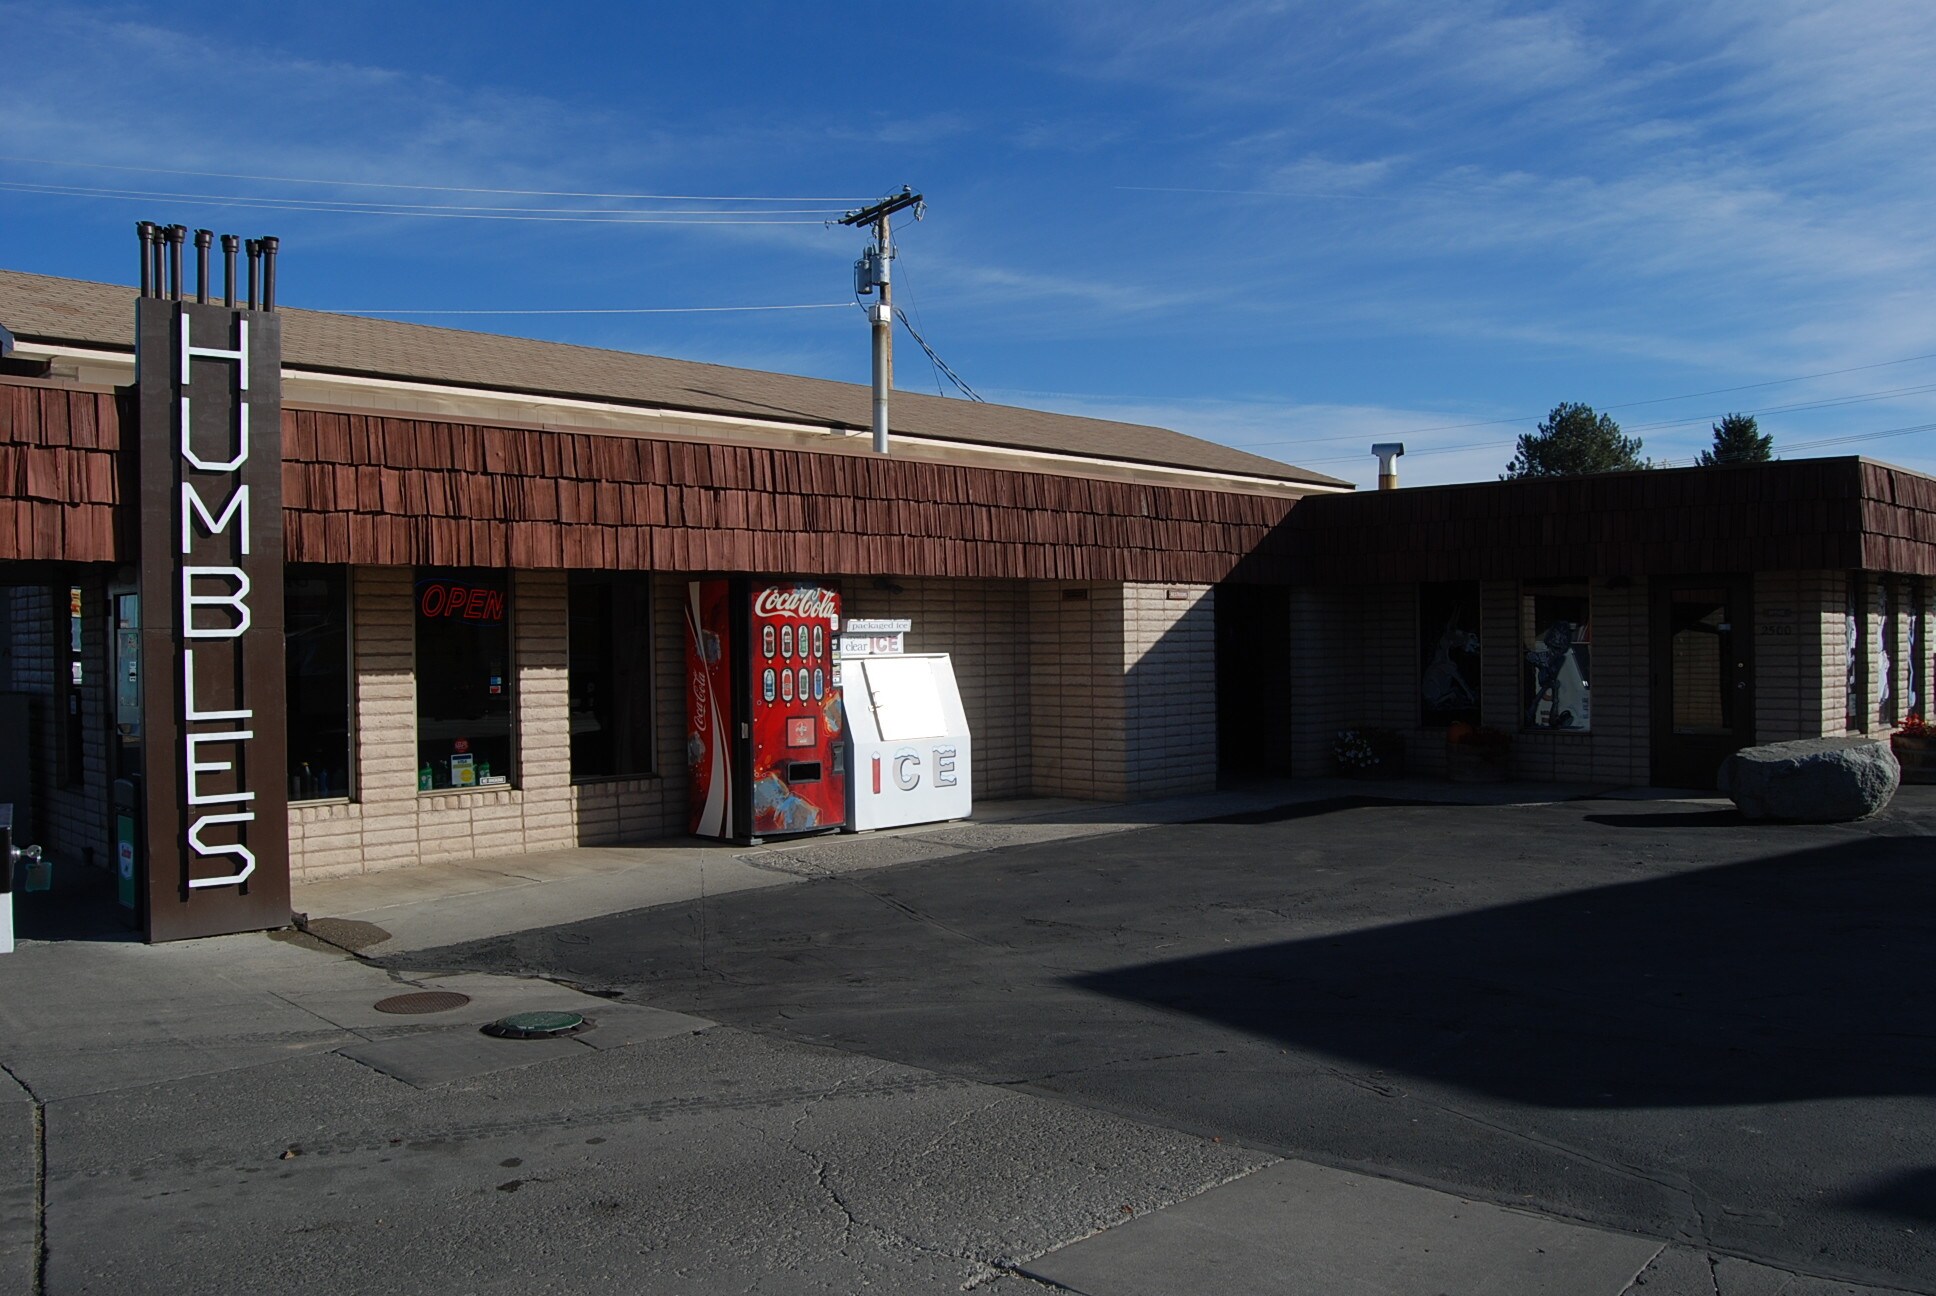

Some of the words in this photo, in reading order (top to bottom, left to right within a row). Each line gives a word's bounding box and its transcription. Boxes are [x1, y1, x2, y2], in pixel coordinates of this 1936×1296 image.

[180, 312, 256, 888] HUMBLES
[422, 585, 503, 619] OPEN
[852, 622, 893, 630] packaged
[1760, 625, 1792, 635] 2500
[845, 641, 868, 652] clear
[870, 636, 898, 652] ICE
[871, 745, 957, 795] ICE
